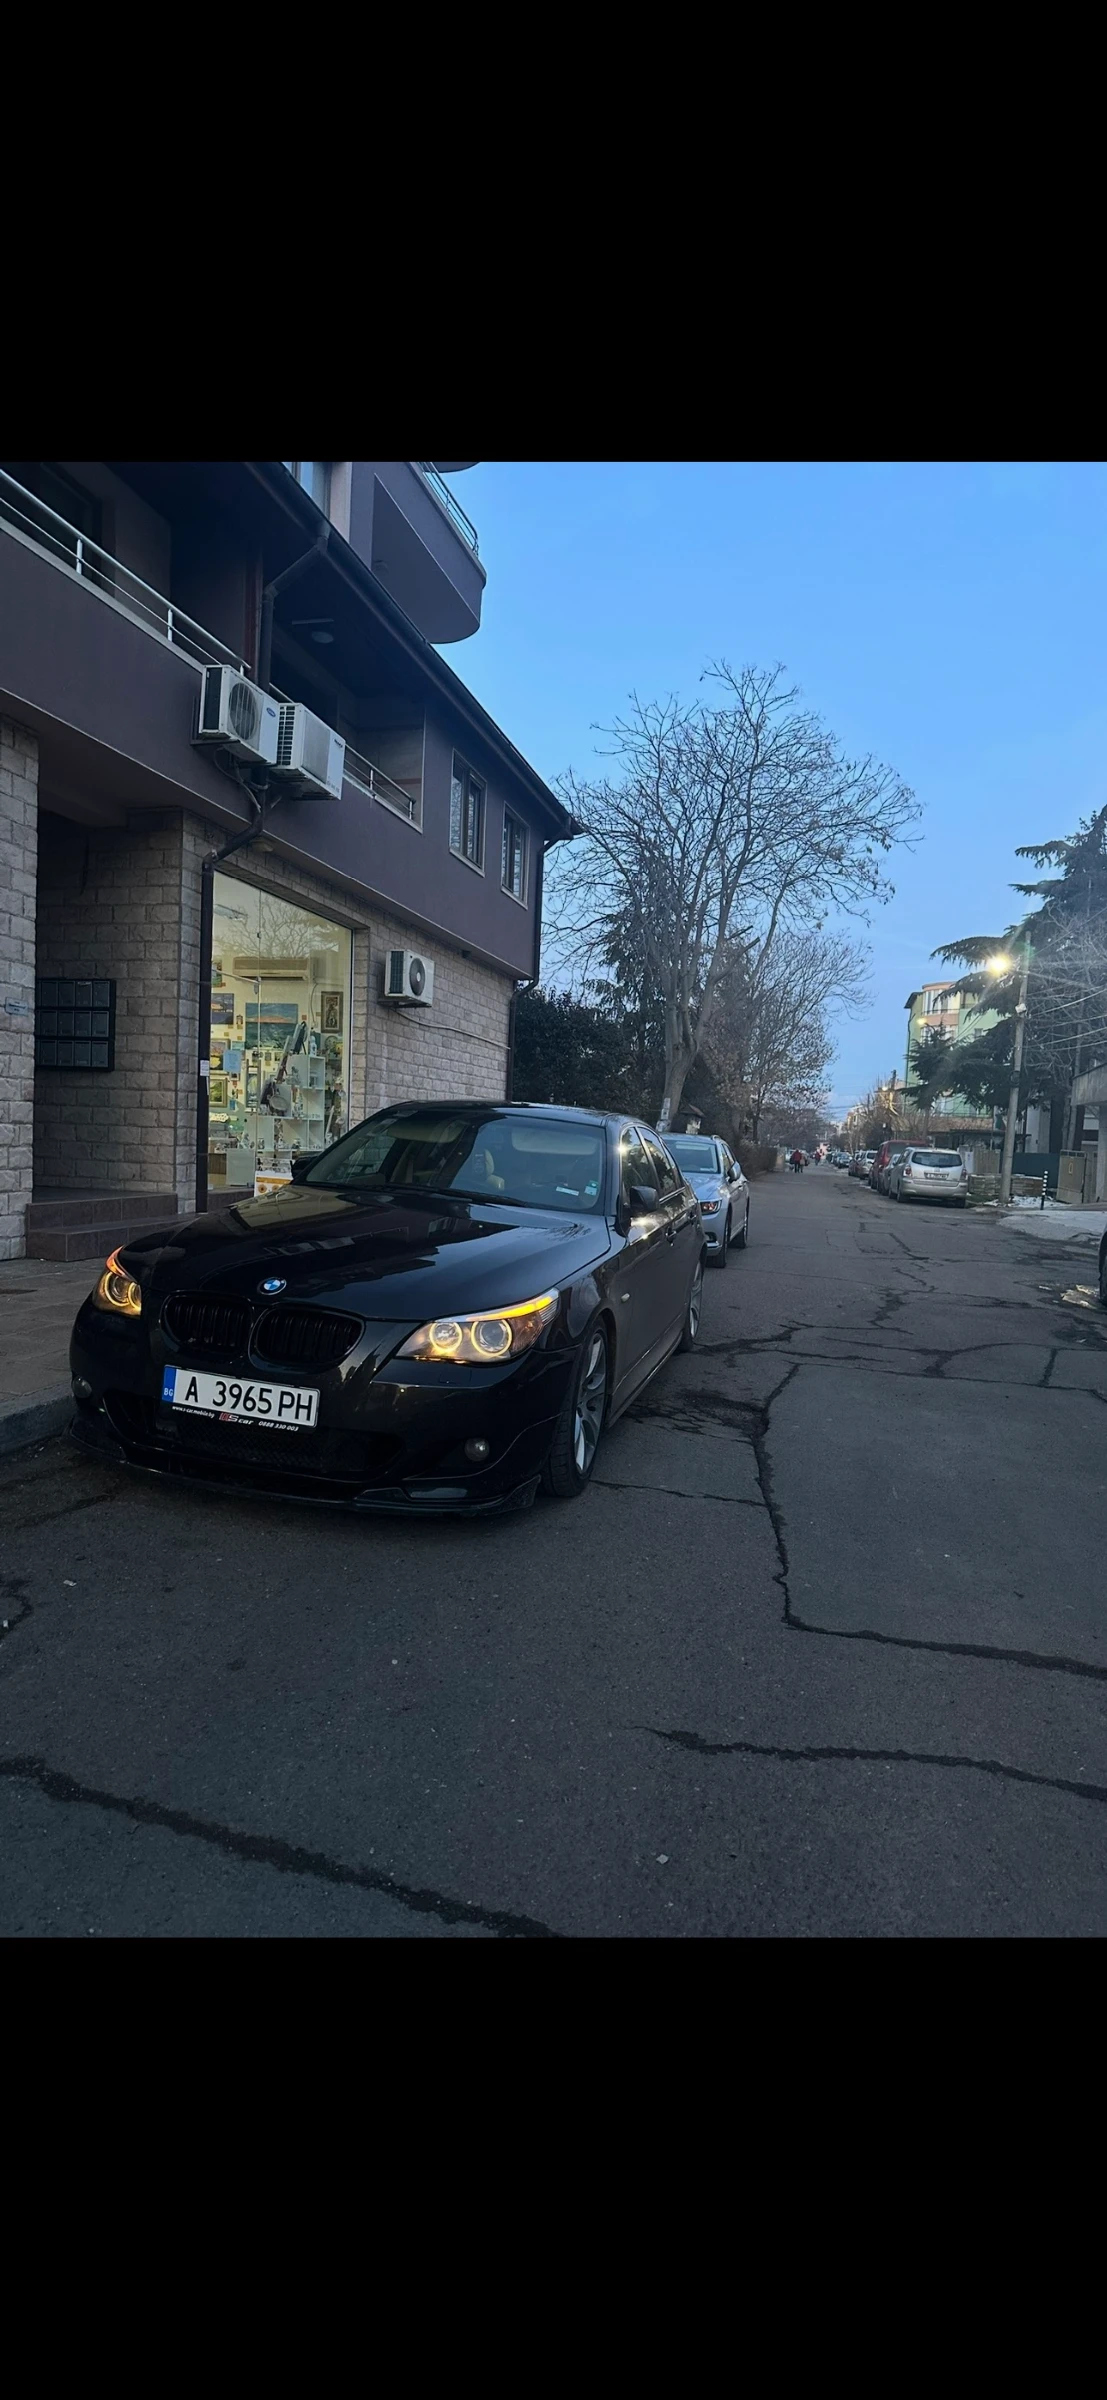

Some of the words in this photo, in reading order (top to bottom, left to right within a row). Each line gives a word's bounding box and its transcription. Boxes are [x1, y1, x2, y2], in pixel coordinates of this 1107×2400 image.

[164, 1388, 174, 1396] BG
[185, 1376, 198, 1403] A
[212, 1380, 272, 1414] 3965
[277, 1390, 313, 1422] PH
